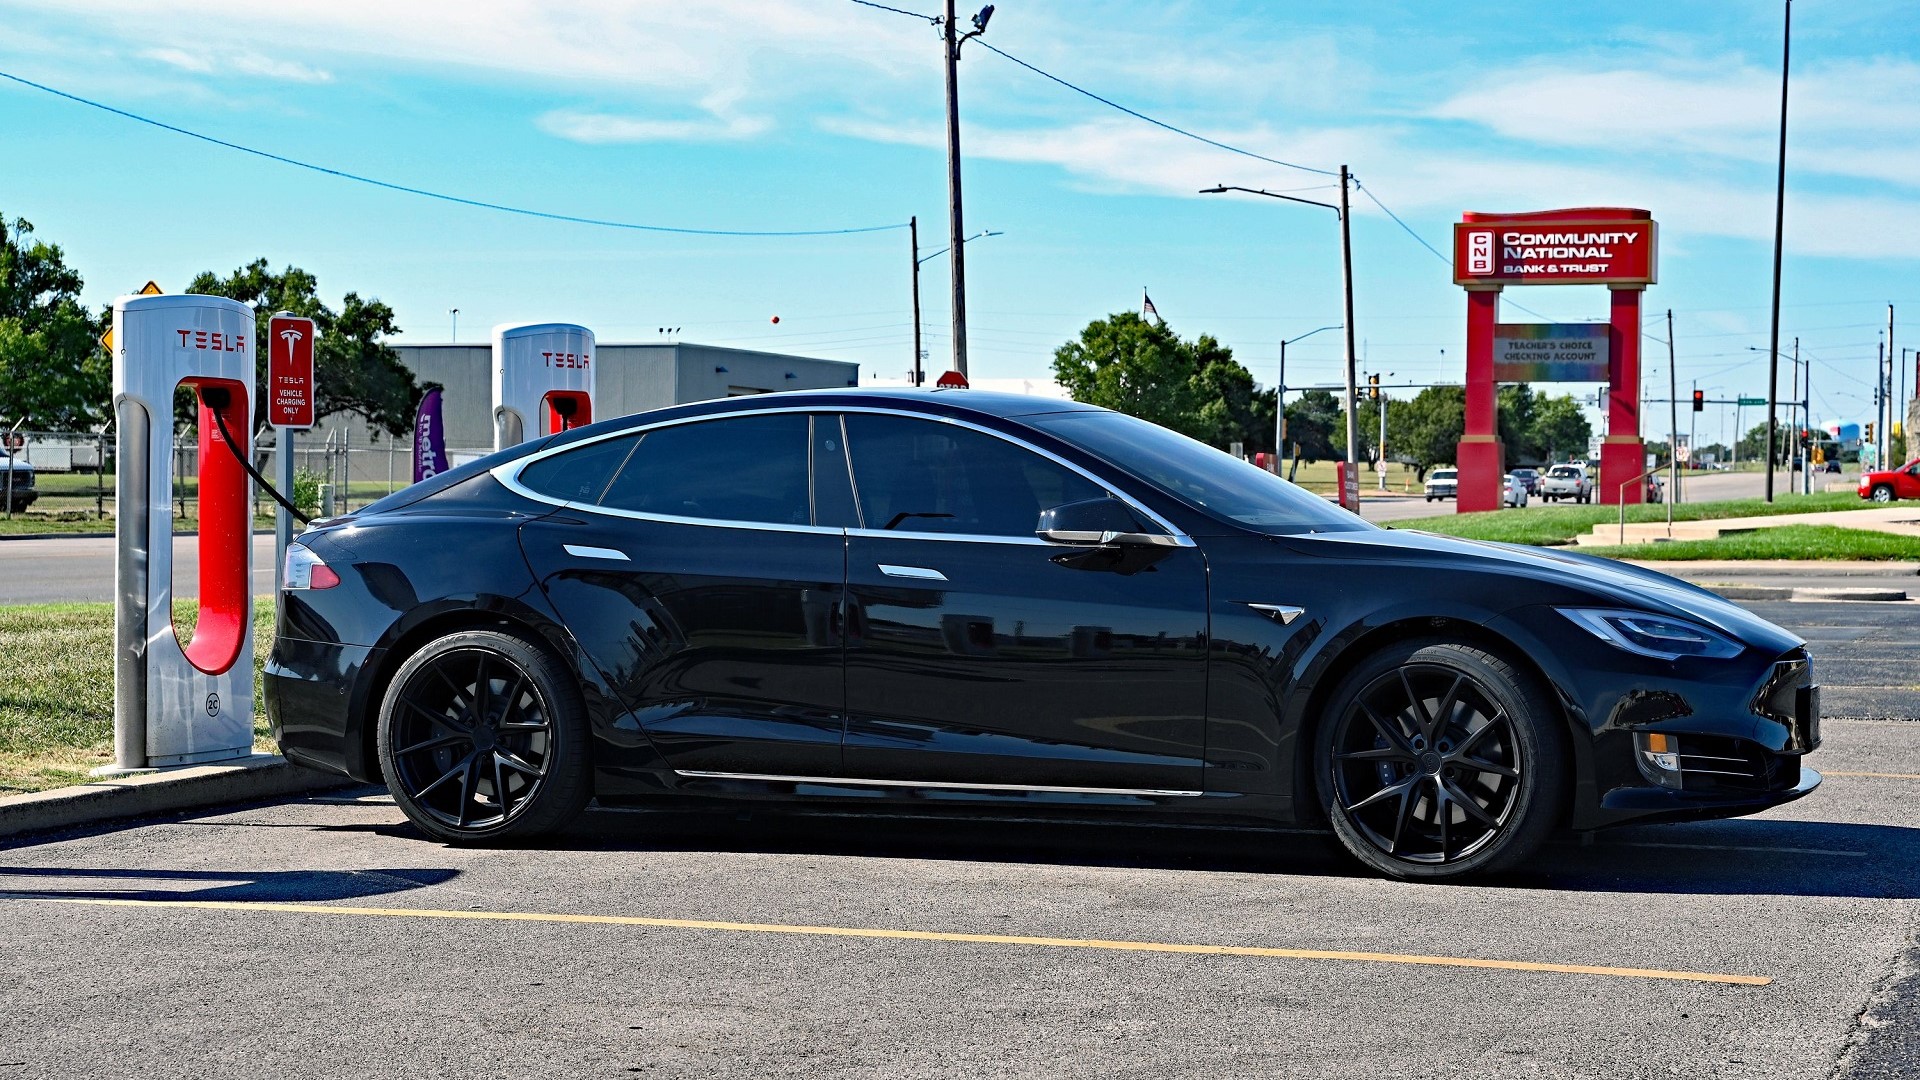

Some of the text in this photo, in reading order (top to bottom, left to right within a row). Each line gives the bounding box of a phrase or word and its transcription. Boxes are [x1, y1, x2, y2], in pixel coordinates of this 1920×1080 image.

[1503, 232, 1638, 245] COMMUNITY
[1474, 235, 1487, 269] CNB
[1503, 247, 1613, 260] NATIONAL
[1503, 263, 1609, 274] BANK & TRUST
[176, 329, 245, 353] TESLA
[1508, 341, 1593, 350] TEACHER'S CHOICE
[542, 352, 590, 369] TESLA
[1504, 352, 1596, 361] CHECKING ACCOUNT
[278, 376, 304, 384] TESLA
[279, 389, 303, 397] VEHICLE
[276, 398, 306, 406] CHARGING
[283, 406, 299, 414] ONLY
[208, 700, 218, 709] 2C
